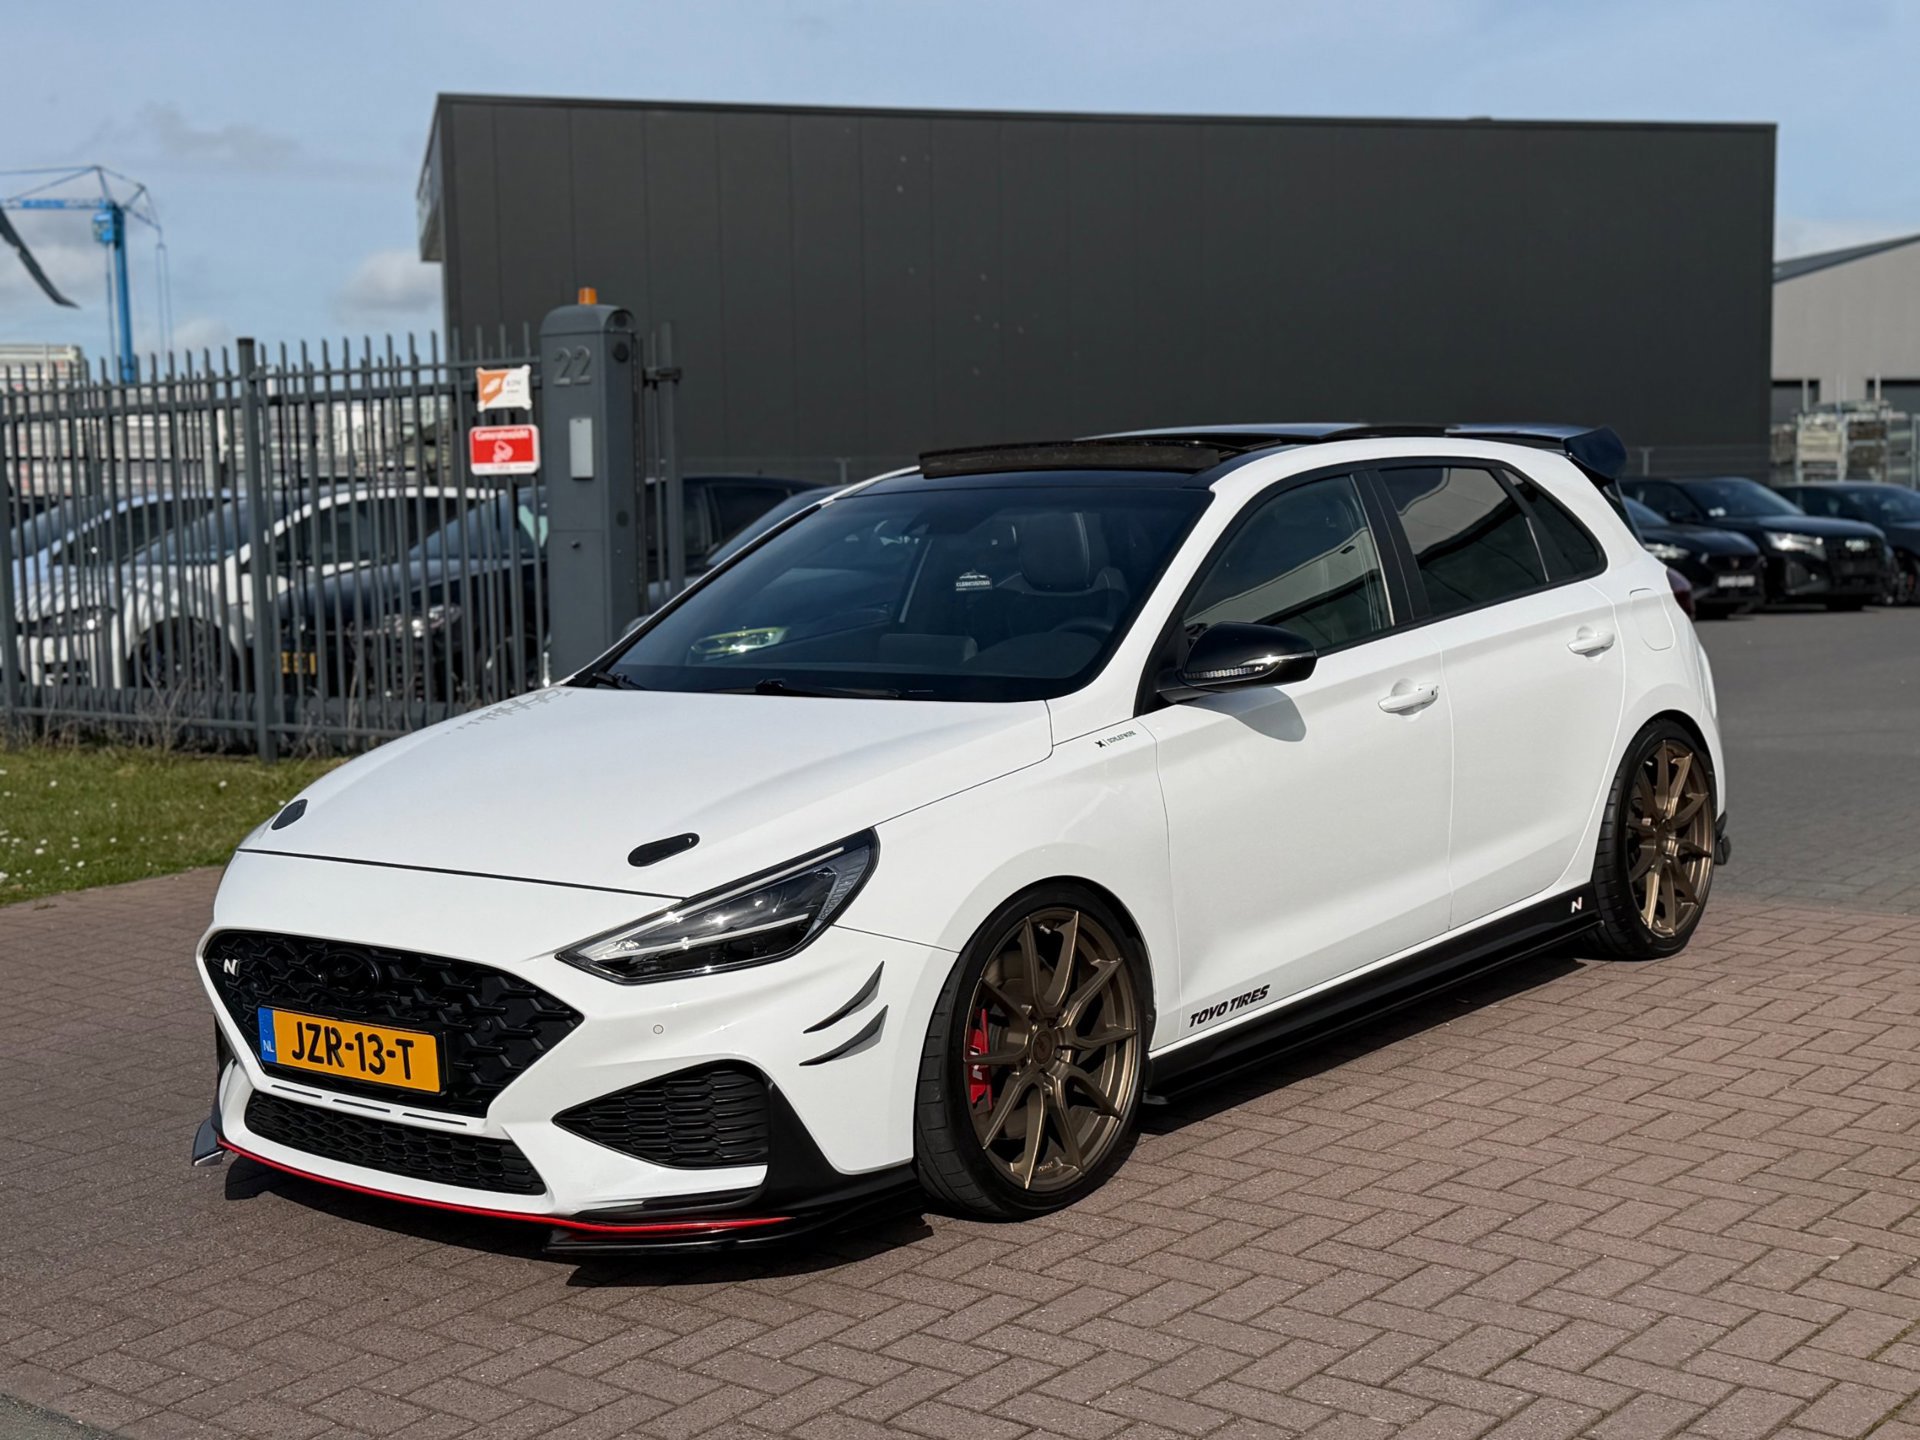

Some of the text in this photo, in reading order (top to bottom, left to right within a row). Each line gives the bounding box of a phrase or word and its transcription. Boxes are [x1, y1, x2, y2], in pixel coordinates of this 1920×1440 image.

[553, 345, 592, 386] 22
[1571, 896, 1582, 914] N
[223, 958, 240, 977] N
[1189, 984, 1270, 1028] TOYO TIRES
[263, 1039, 275, 1053] NL
[292, 1021, 415, 1081] JZR-13-T
